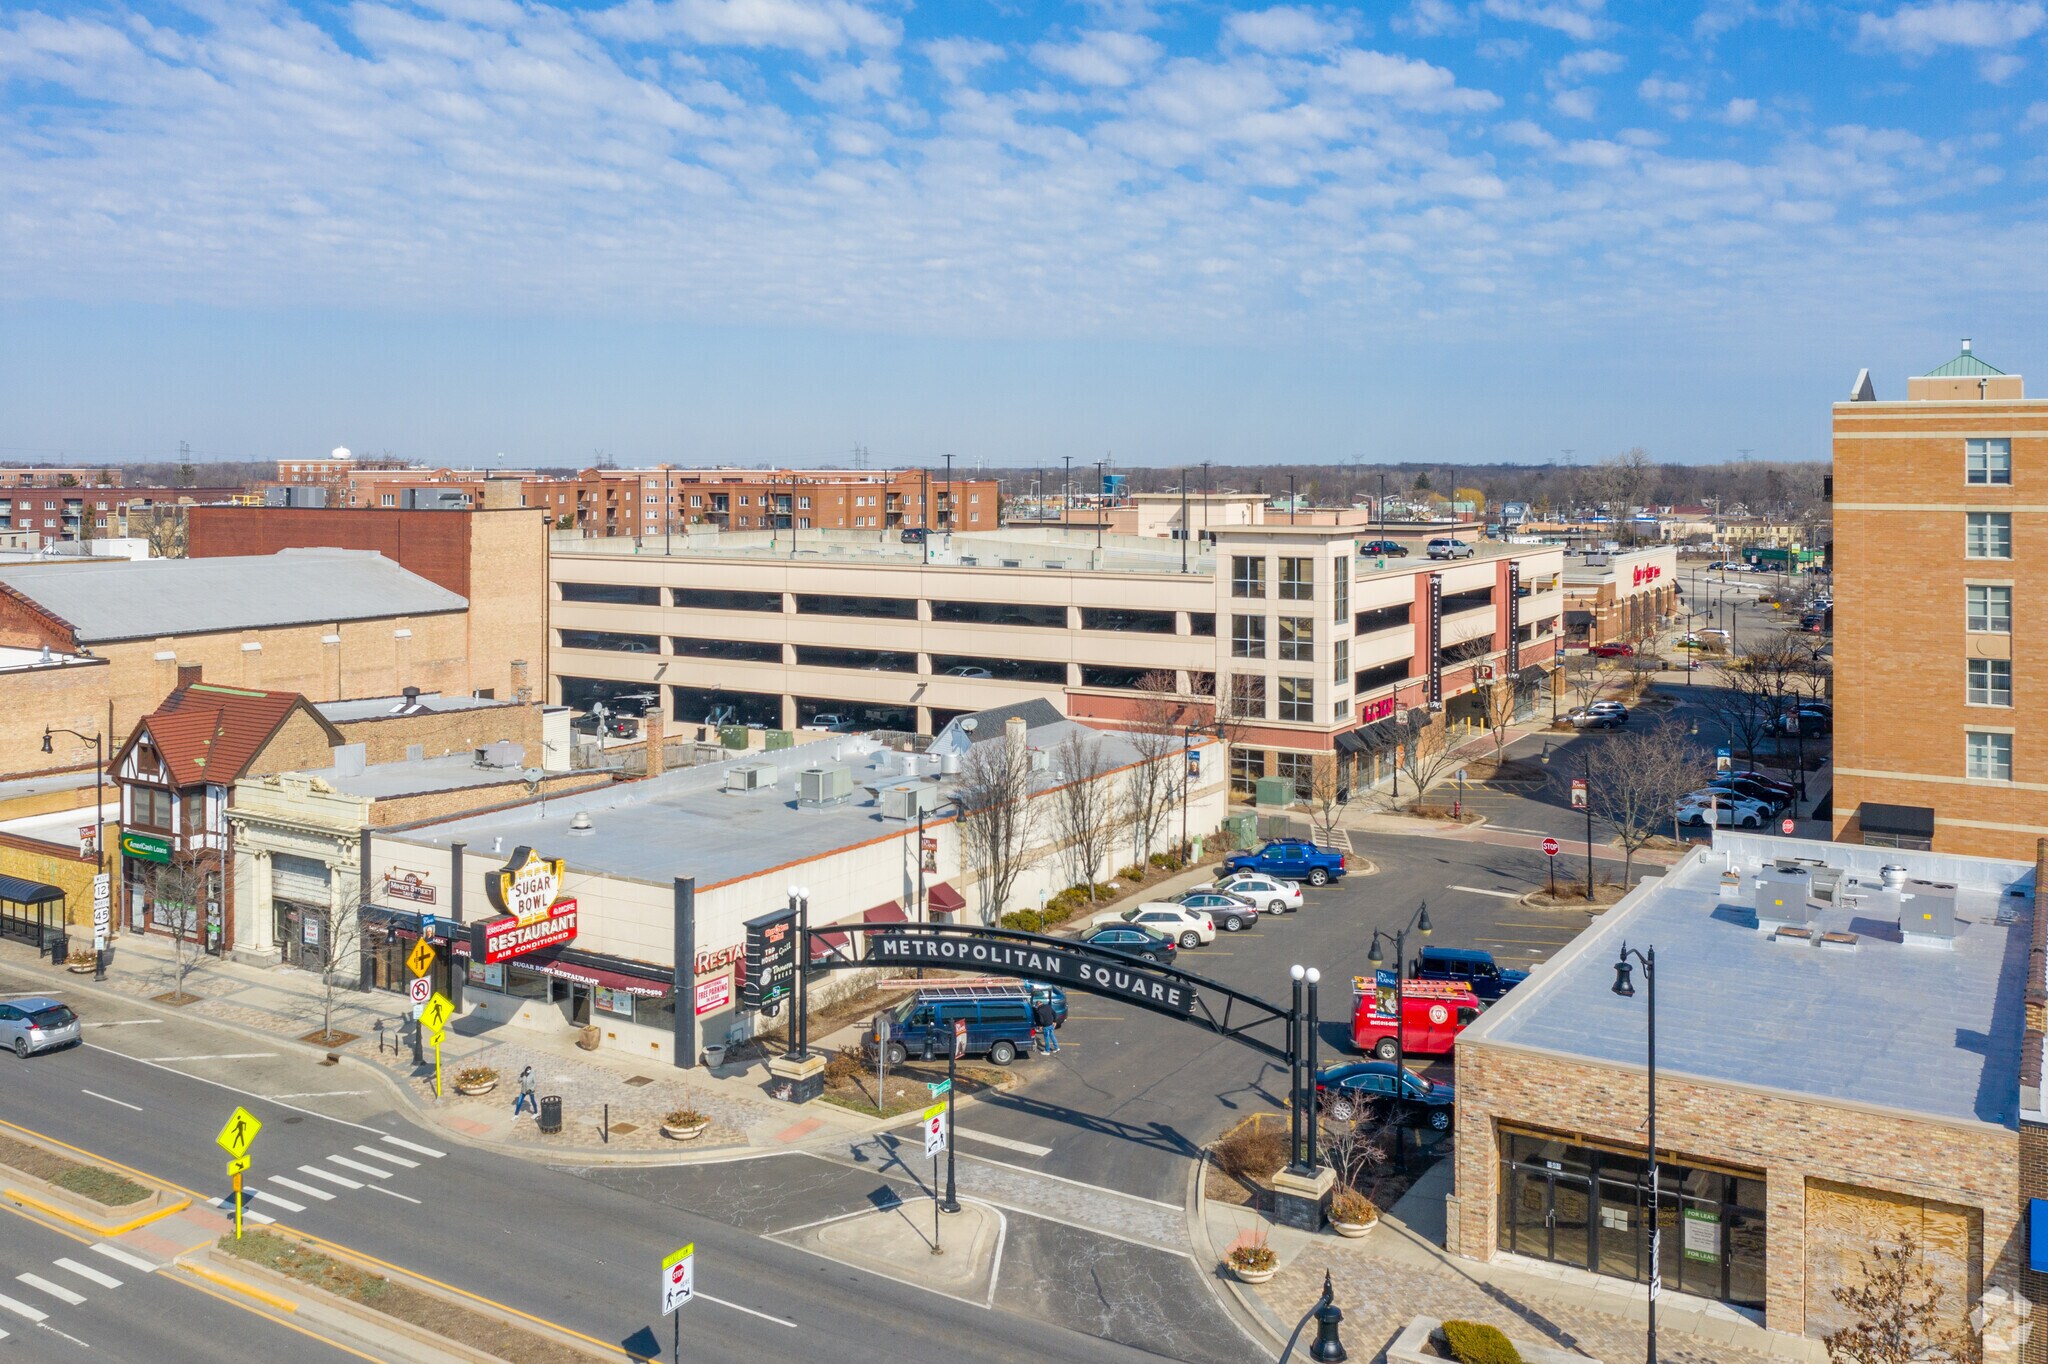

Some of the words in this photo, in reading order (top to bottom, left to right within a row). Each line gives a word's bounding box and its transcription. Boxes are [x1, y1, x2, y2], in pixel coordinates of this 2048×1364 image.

[1481, 666, 1491, 678] P
[129, 841, 153, 852] AmeriCash
[153, 845, 168, 855] Loans
[1543, 842, 1558, 851] STOP
[97, 885, 107, 896] 12
[390, 881, 410, 891] MINER
[410, 885, 433, 896] STREET
[518, 894, 548, 914] BOWL
[95, 910, 108, 921] 45
[488, 913, 577, 953] RESTAURANT
[496, 949, 512, 959] AIR
[514, 931, 569, 953] CONDITIONED
[512, 961, 534, 971] SUGAR
[535, 965, 554, 975] BOWL
[554, 969, 600, 985] RESTAURANT
[883, 940, 1060, 973] METROPOLITAN
[1080, 963, 1180, 1006] SQUARE
[698, 990, 708, 1000] FREE
[709, 983, 728, 996] PARKING
[772, 1005, 779, 1016] P
[1687, 1210, 1700, 1218] FOR
[1700, 1212, 1719, 1221] LEASE
[1687, 1250, 1700, 1258] FOR
[672, 1267, 685, 1279] STOP
